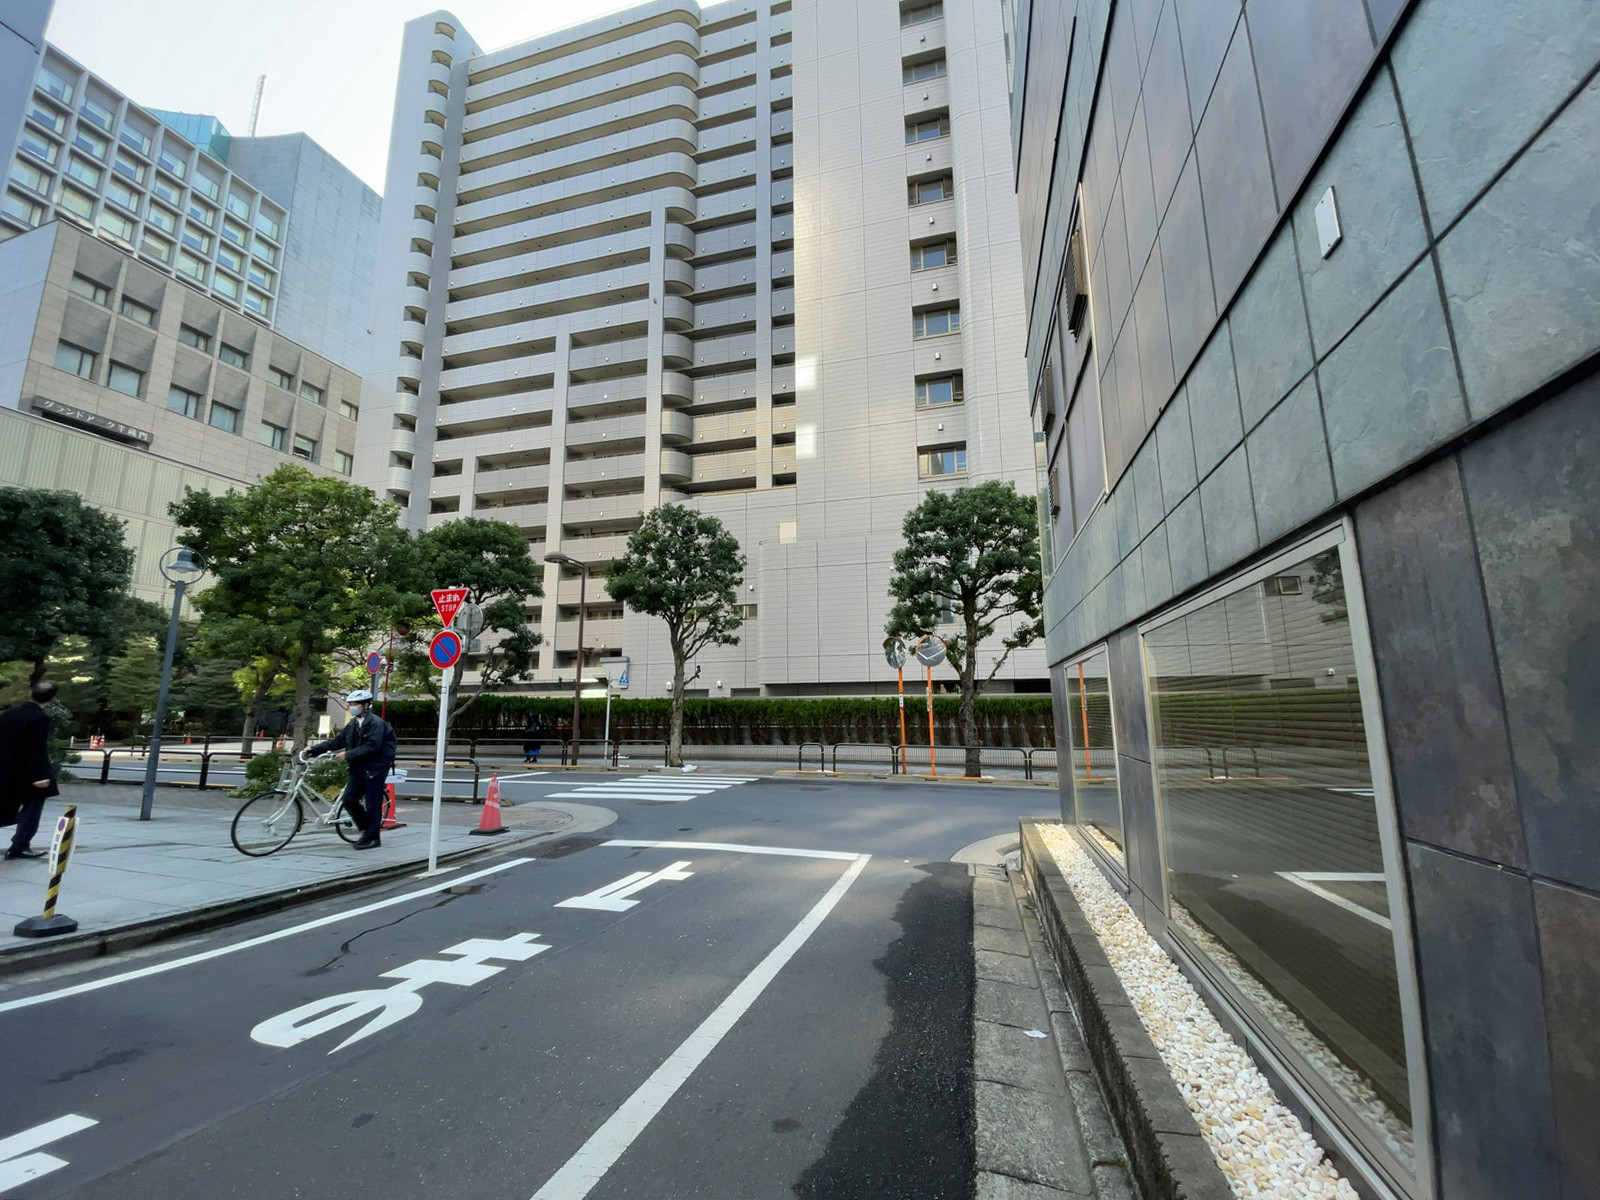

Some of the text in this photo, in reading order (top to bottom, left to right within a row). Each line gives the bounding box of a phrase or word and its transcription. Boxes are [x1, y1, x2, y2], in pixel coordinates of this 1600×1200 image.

[438, 593, 460, 603] 止まれ
[441, 604, 457, 612] STOP
